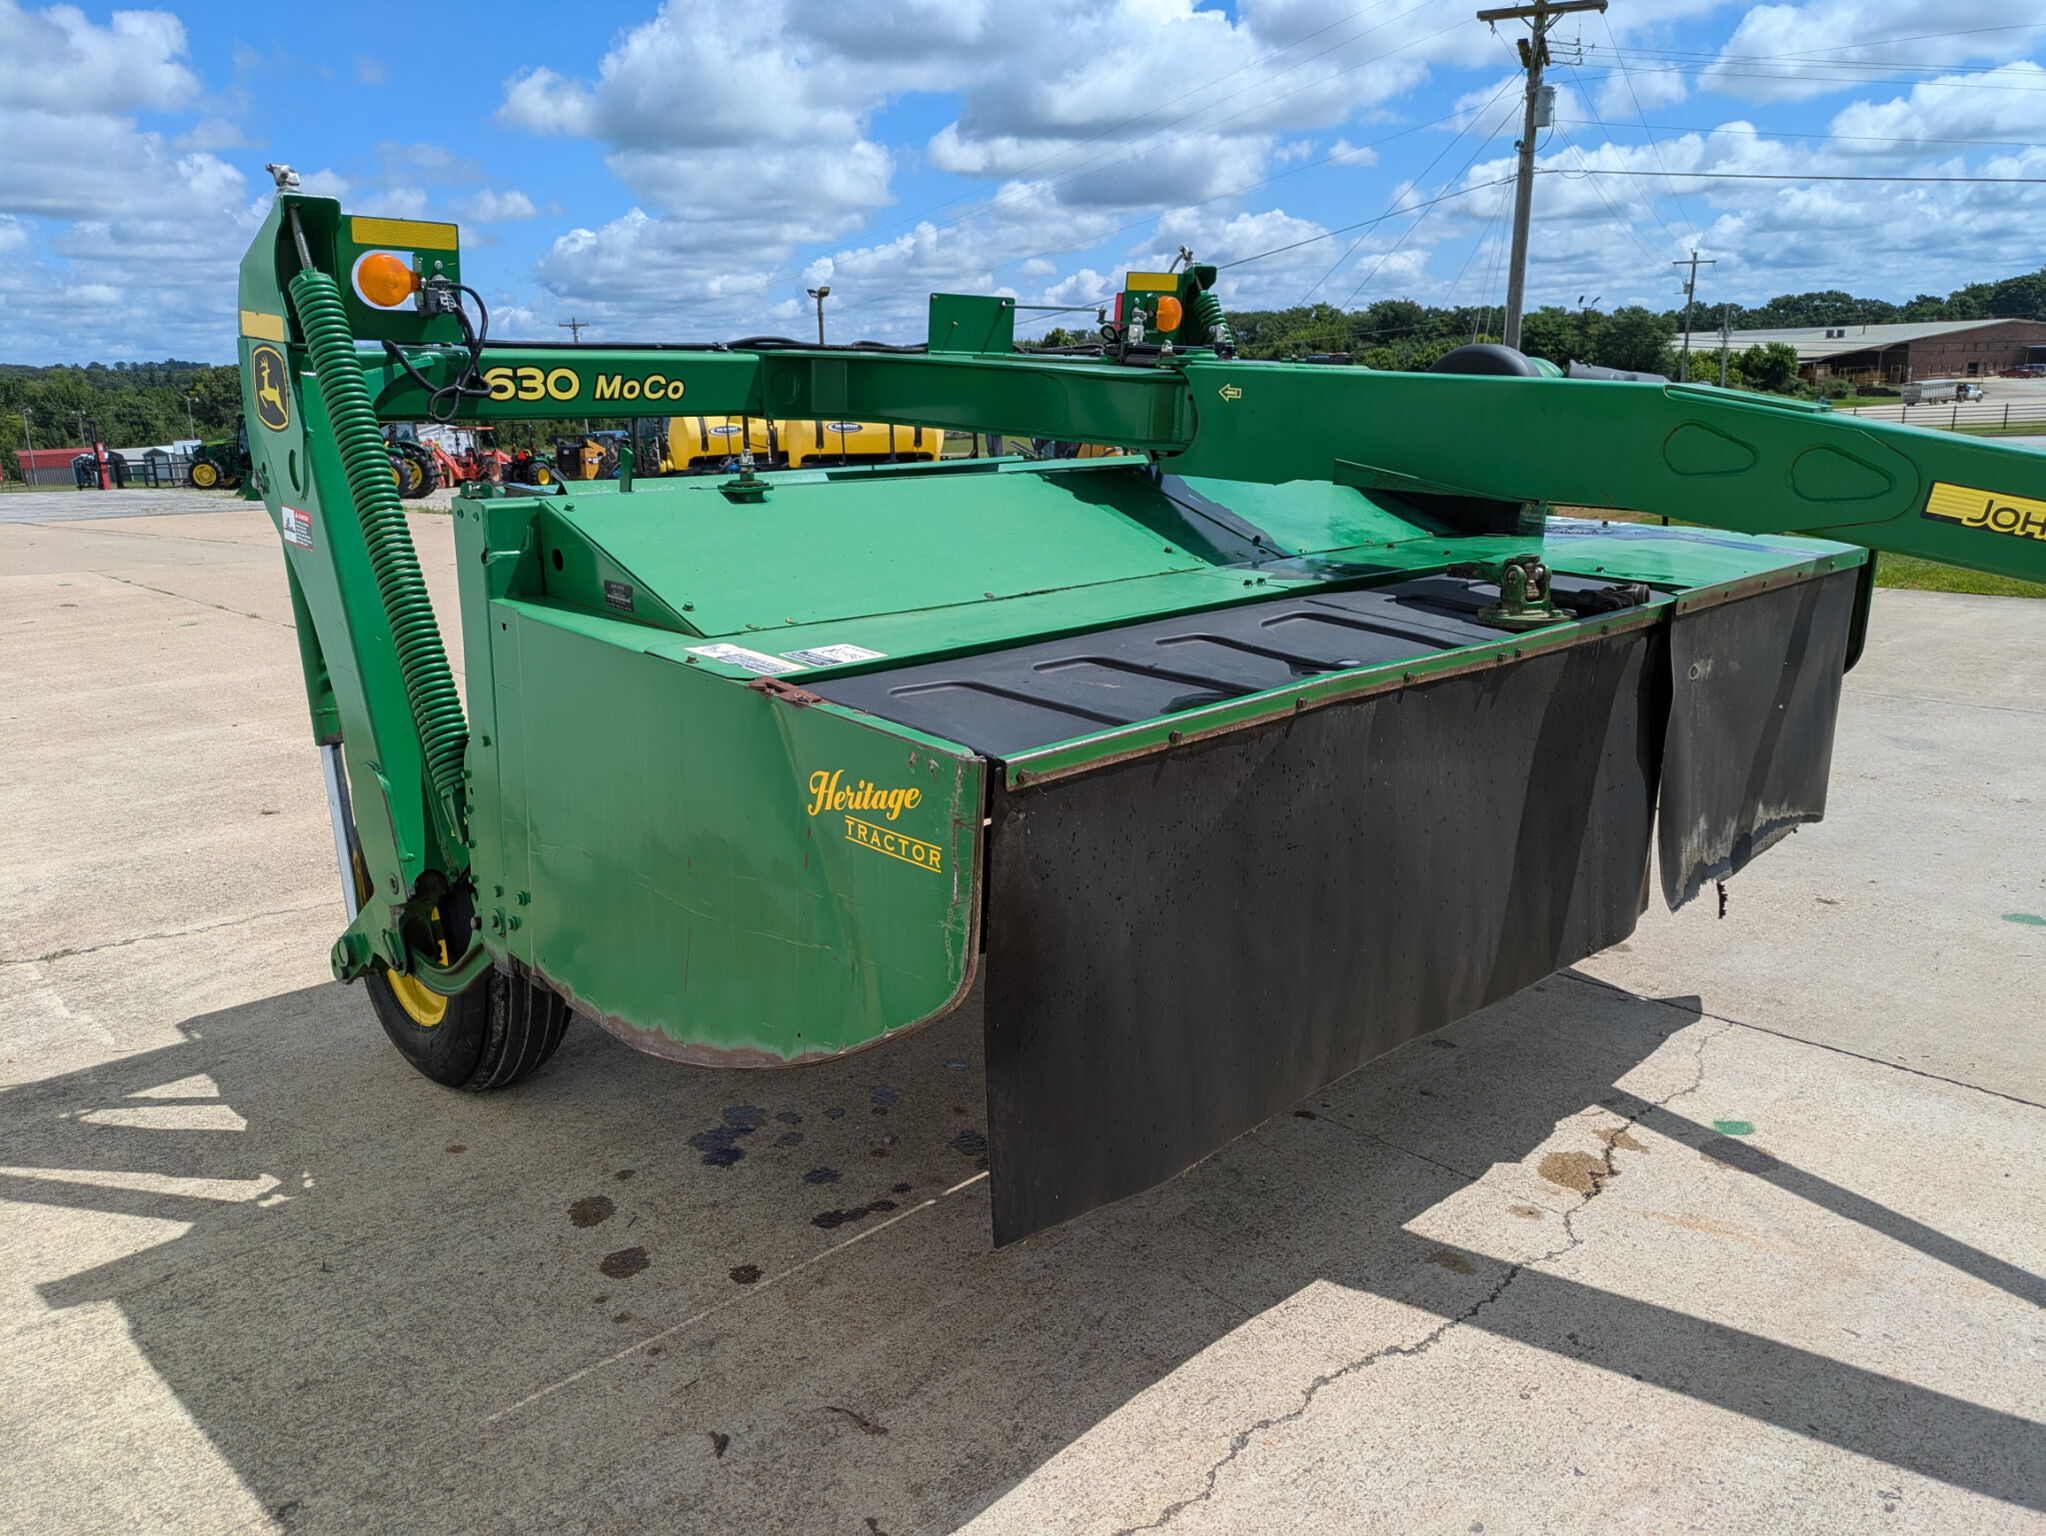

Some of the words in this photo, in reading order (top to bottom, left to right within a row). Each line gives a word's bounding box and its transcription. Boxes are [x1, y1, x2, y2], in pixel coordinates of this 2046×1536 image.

[482, 367, 581, 401] 630
[594, 374, 686, 400] MoCo
[807, 769, 922, 821] Heritage
[845, 819, 941, 868] TRACTOR
